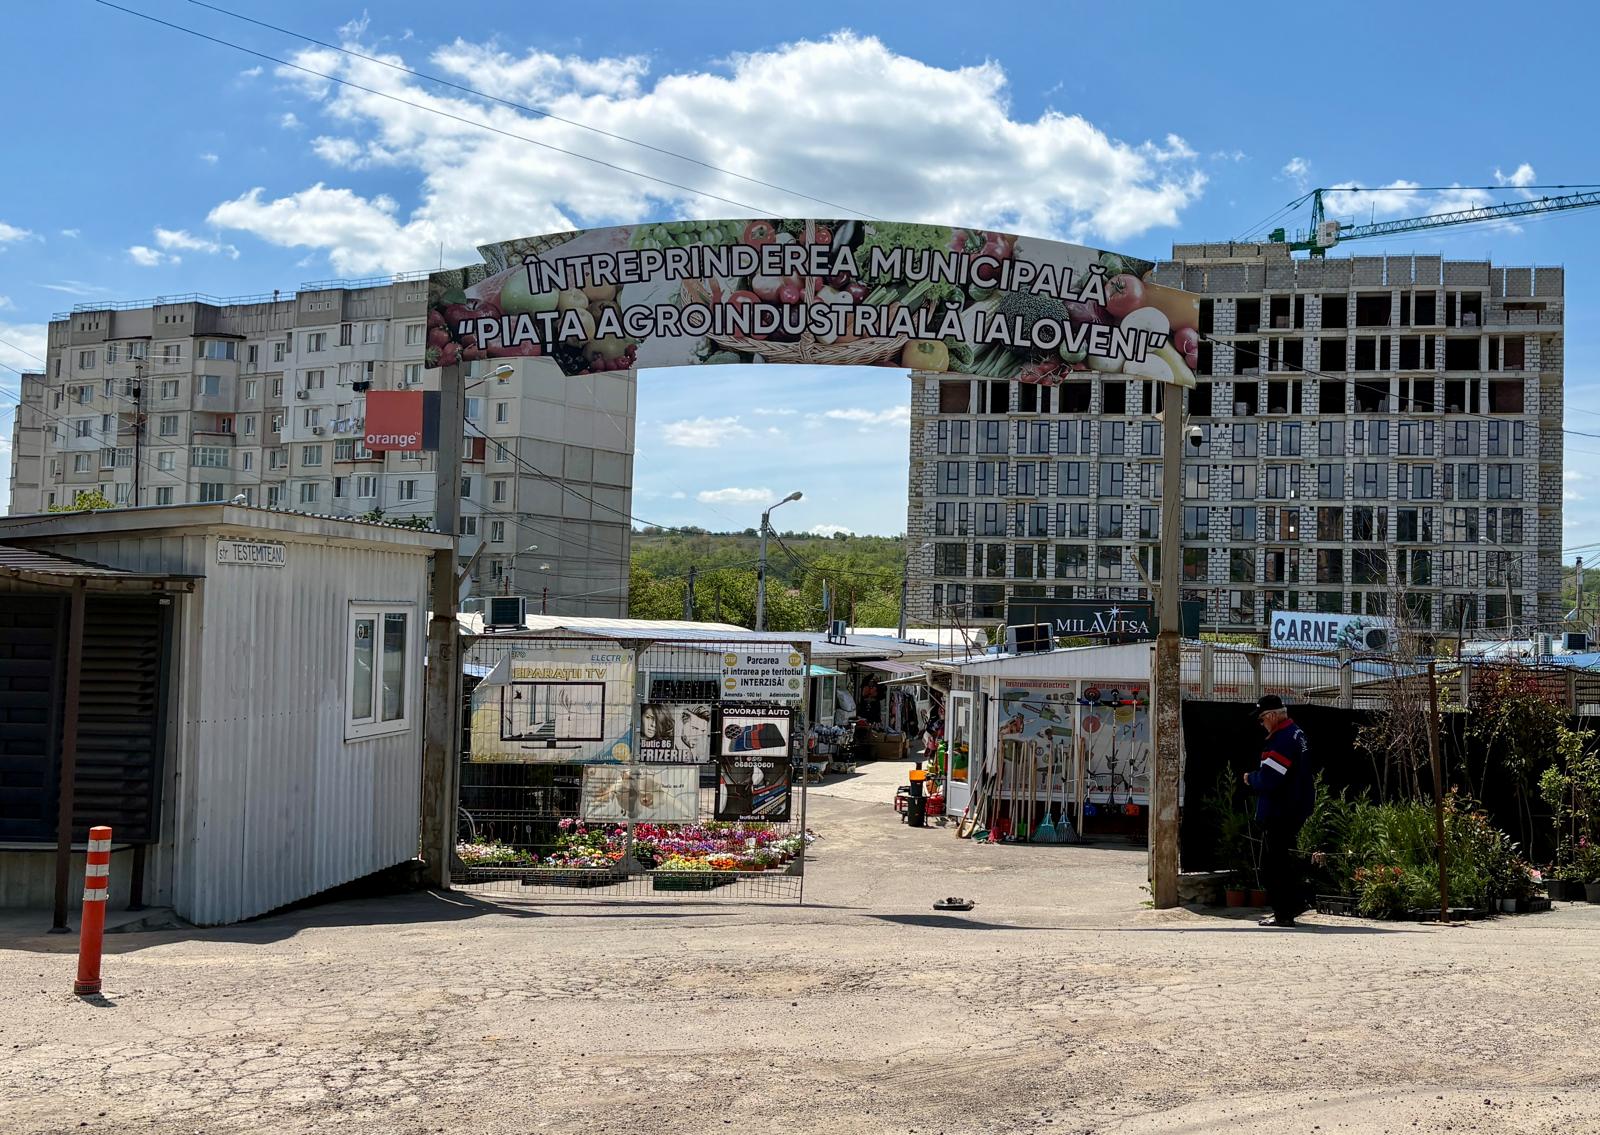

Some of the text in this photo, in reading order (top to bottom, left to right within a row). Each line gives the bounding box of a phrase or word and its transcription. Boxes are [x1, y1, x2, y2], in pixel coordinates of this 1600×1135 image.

[523, 243, 1108, 306] ÎNTREPRINDEREA MUNICIPALĂ
[595, 302, 964, 341] AGROINDUSTRIALĂ
[366, 434, 416, 447] orange
[1274, 618, 1338, 643] CARNE
[747, 656, 779, 664] Parcarea
[585, 668, 607, 679] TV
[731, 667, 759, 675] intrarea
[761, 669, 770, 677] pe
[640, 749, 690, 762] FRIZERIE
